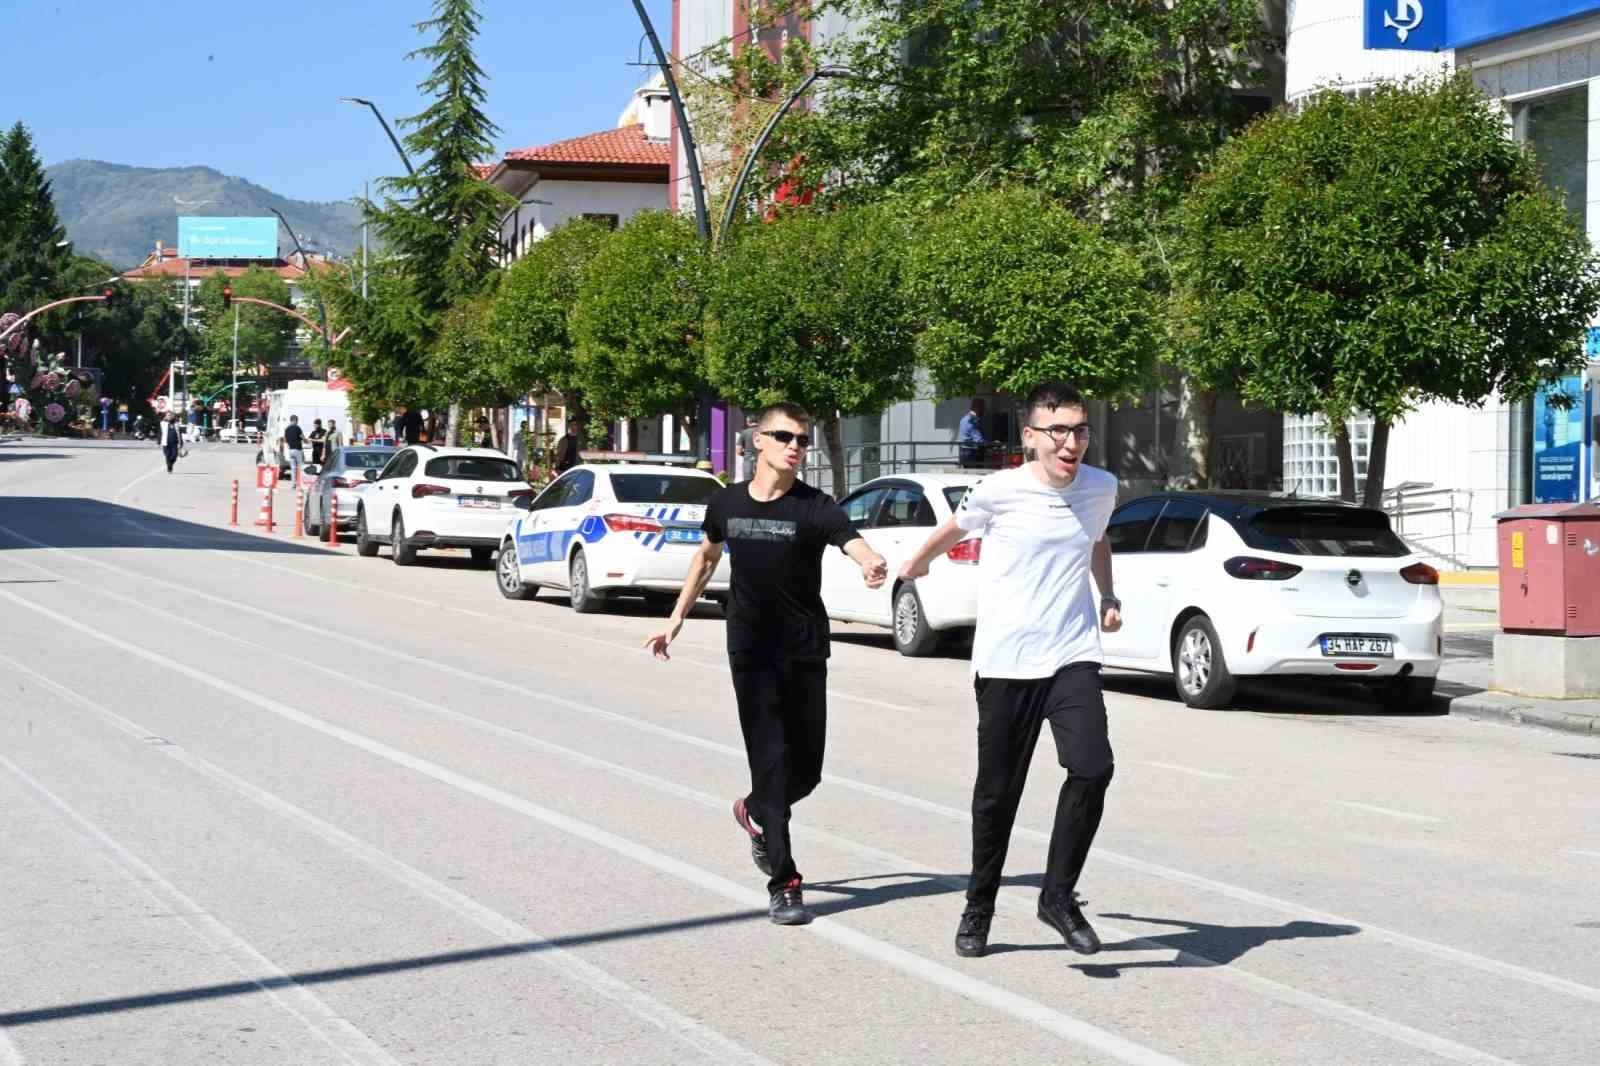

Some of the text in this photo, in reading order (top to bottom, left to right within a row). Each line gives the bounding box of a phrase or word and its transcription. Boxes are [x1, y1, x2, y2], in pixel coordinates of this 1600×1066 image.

[1328, 637, 1388, 652] 34 HAP 267
